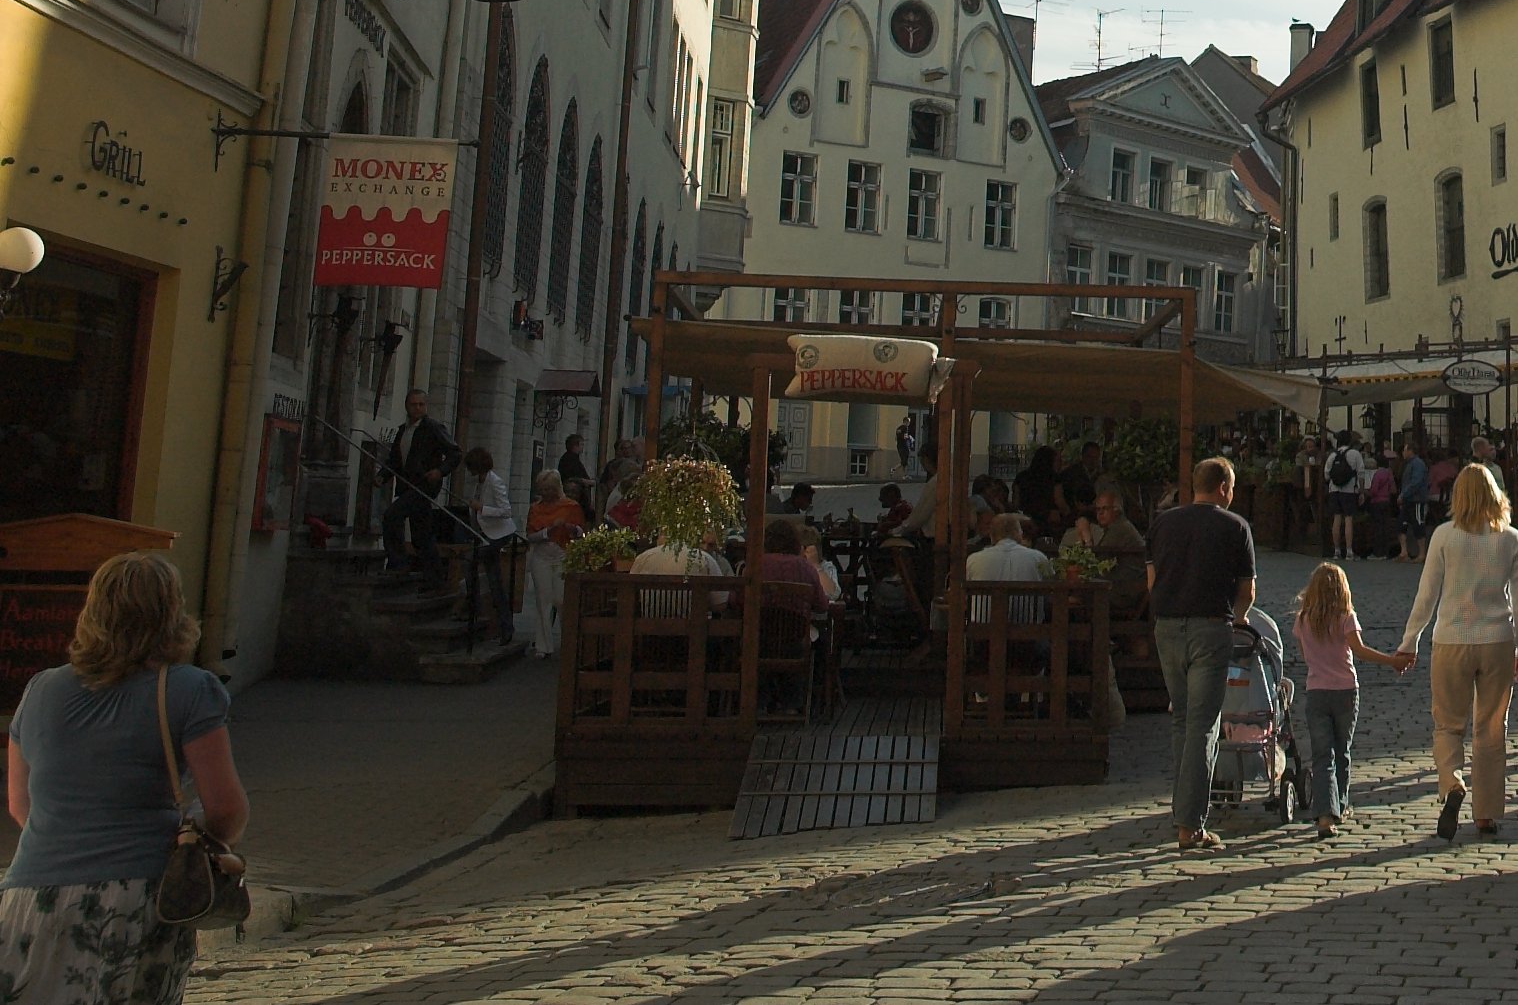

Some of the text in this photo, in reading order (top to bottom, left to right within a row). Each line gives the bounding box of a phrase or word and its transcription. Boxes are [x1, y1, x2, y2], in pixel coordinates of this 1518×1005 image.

[332, 158, 448, 183] MONEX
[329, 183, 446, 197] EXCHANGE
[321, 250, 437, 269] PEPPERSACK
[801, 368, 908, 392] PEPPERSACK
